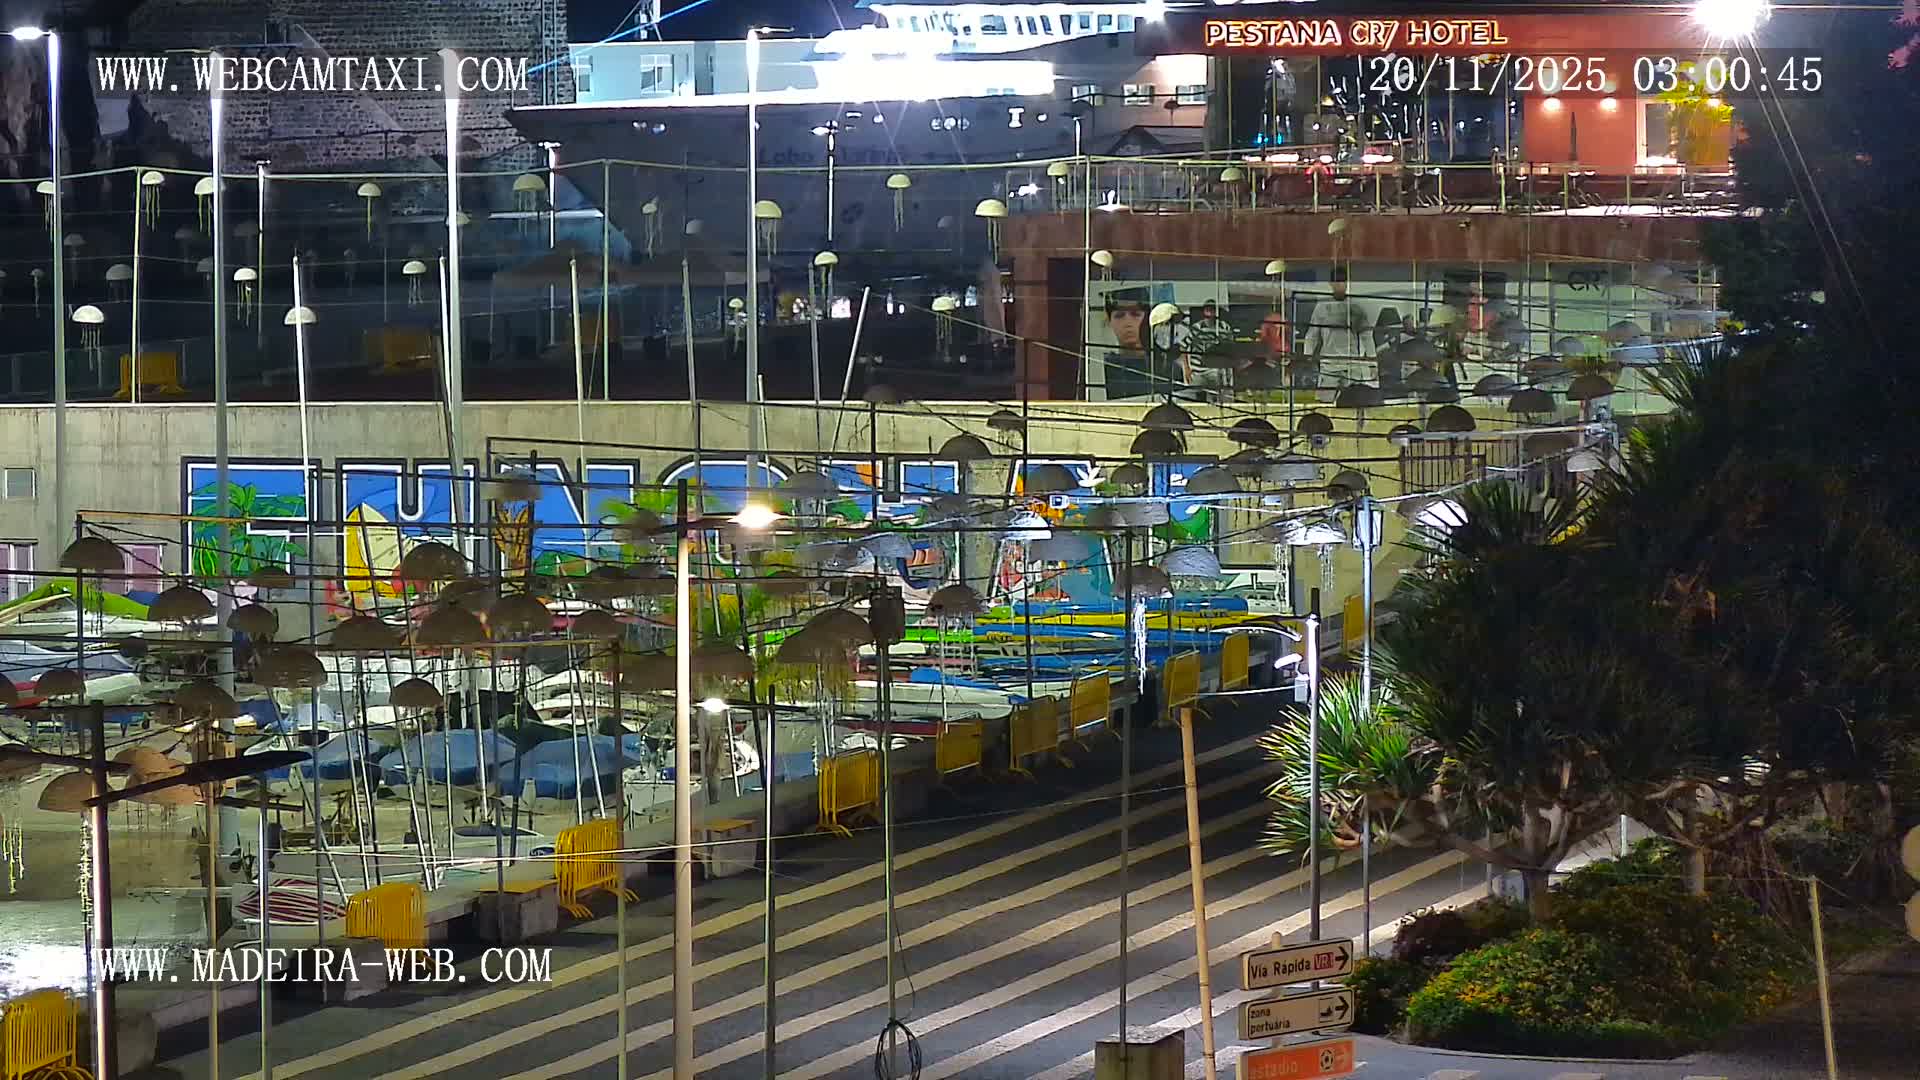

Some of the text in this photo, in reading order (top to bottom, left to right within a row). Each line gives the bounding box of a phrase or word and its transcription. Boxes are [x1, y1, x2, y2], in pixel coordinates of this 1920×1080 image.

[1206, 20, 1508, 51] PESTANA CR7 HOTEL
[1251, 965, 1268, 979] Via
[1273, 958, 1311, 977] Rápida
